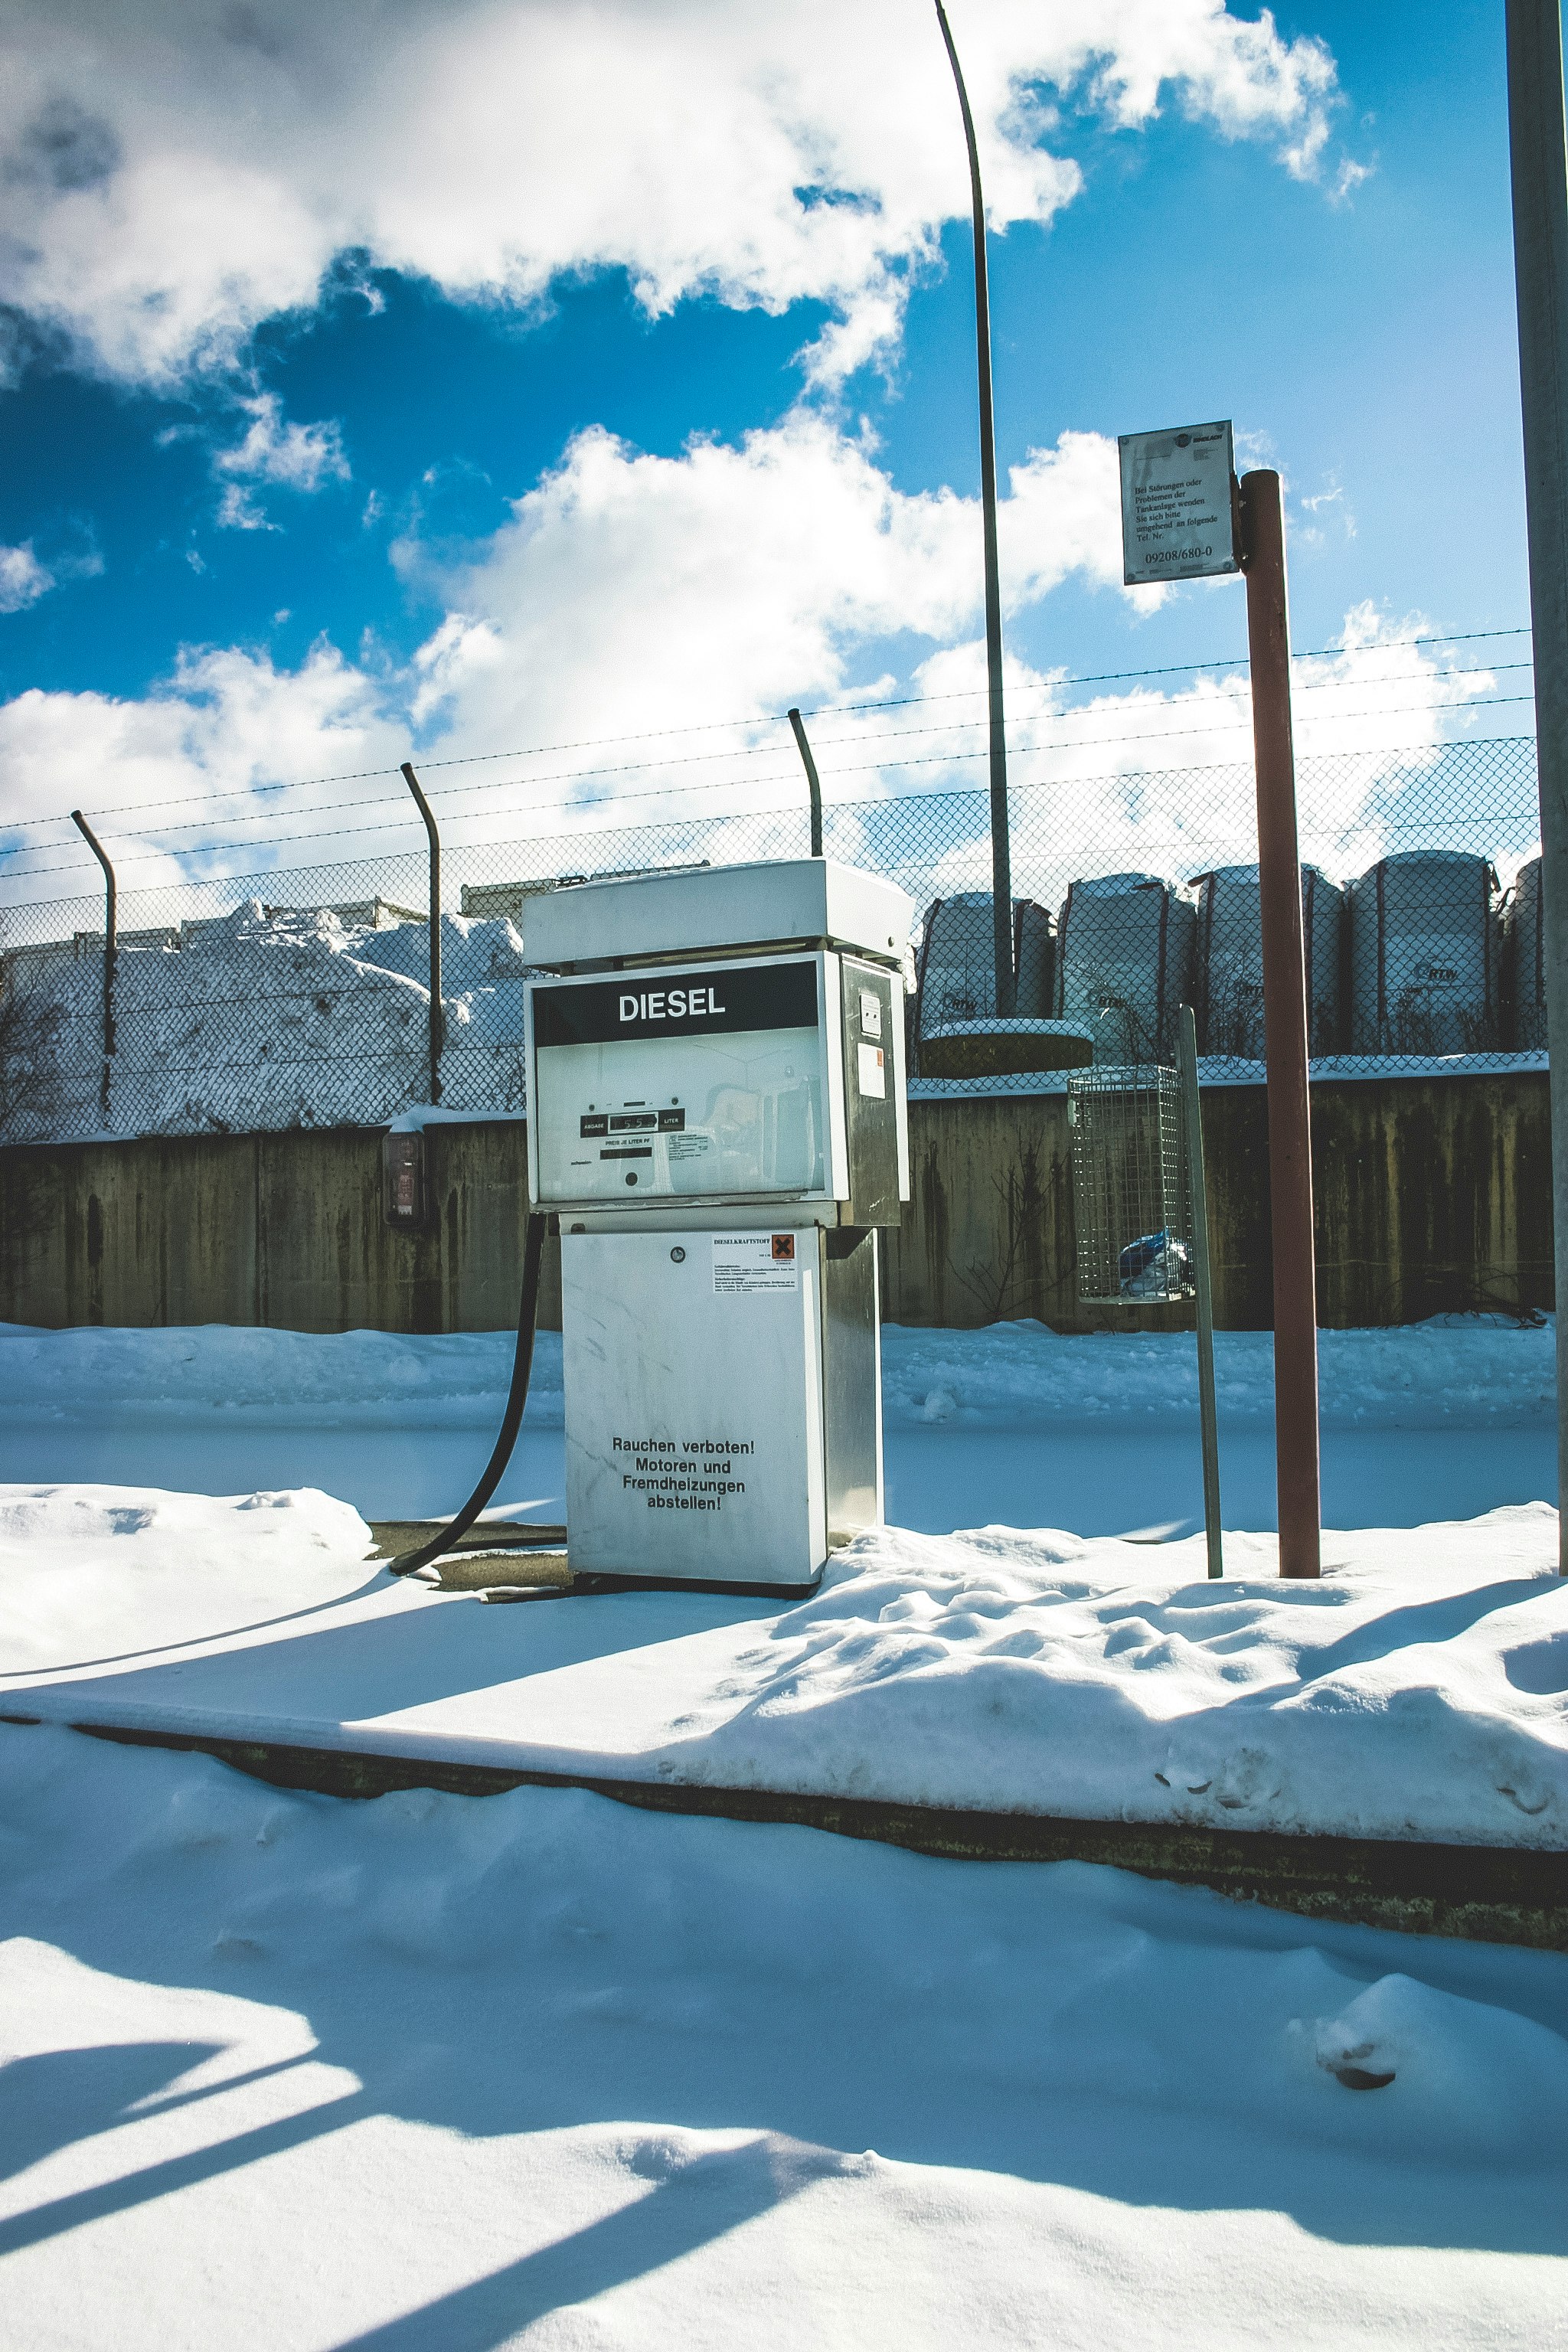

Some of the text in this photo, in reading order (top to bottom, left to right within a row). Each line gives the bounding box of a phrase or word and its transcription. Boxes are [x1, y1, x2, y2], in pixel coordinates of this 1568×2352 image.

[1148, 482, 1184, 492] Störungen
[1186, 479, 1202, 487] oder
[1135, 493, 1173, 504] Problemen
[1135, 498, 1205, 514] Tankanlage wenden
[1136, 521, 1173, 533] umgehend
[1187, 514, 1218, 526] folgende
[1149, 512, 1164, 521] sich
[1165, 511, 1181, 519] bitte
[1145, 546, 1213, 564] 09208/680-0
[619, 988, 726, 1021] DIESEL
[612, 1437, 755, 1454] Rauchen verboten!
[635, 1457, 731, 1474] Motoren und
[622, 1475, 746, 1494] Fremdheizungen
[647, 1494, 721, 1511] abstellen!
